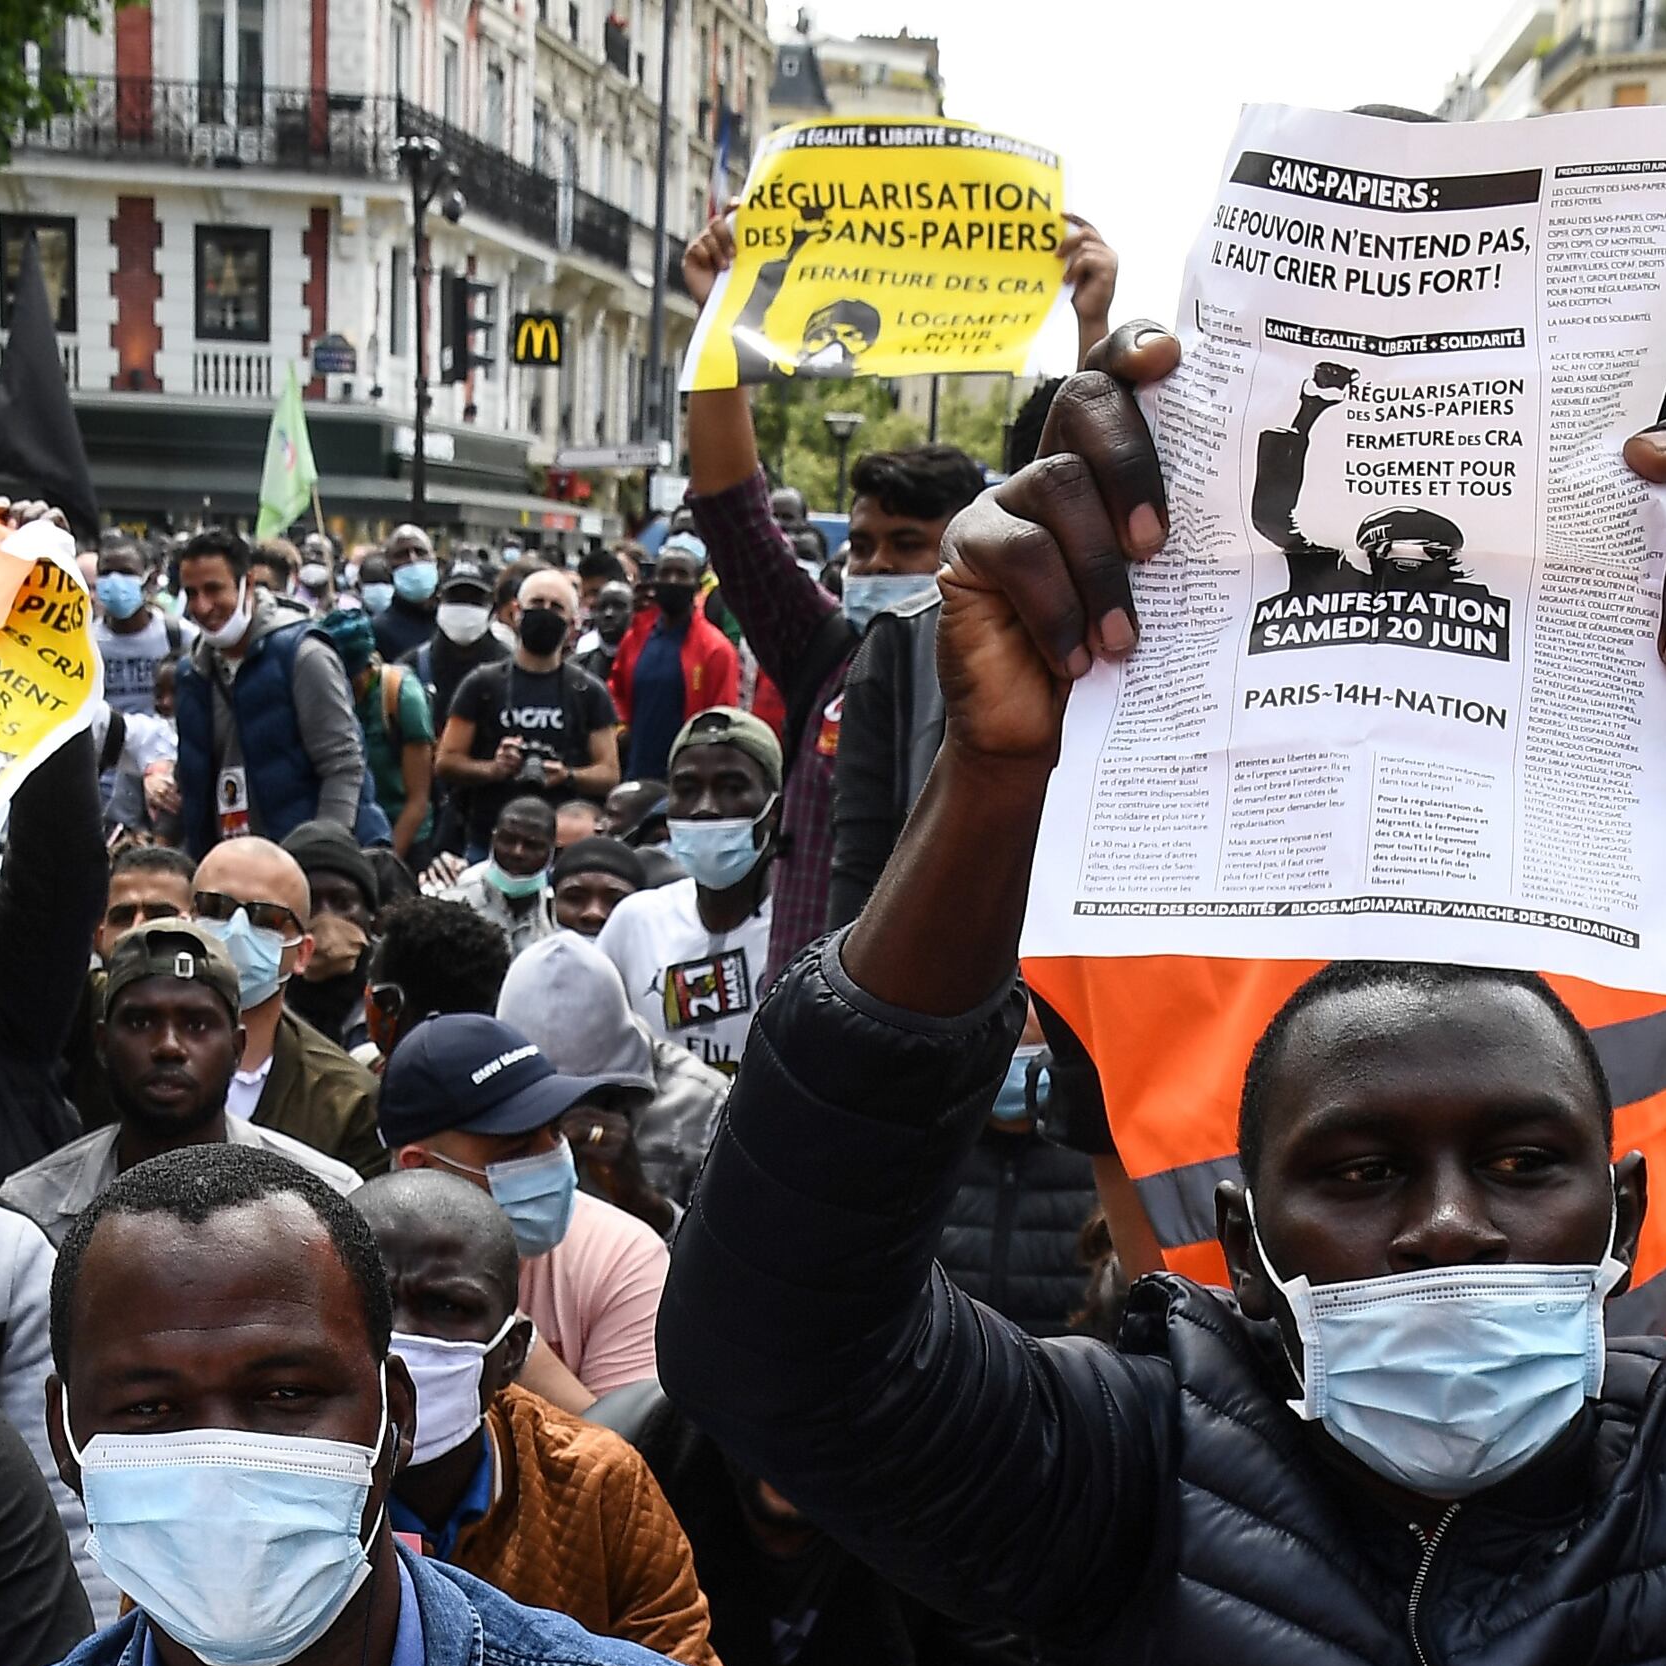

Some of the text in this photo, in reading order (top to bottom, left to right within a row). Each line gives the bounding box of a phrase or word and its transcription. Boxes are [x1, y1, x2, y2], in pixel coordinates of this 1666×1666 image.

[880, 126, 945, 146] LIBERTÉ
[748, 173, 1051, 211] RÉGULARISATION
[745, 219, 1058, 252] DES SANS-PAPIERS
[1223, 208, 1235, 230] LE
[1239, 211, 1325, 251] POUVOIR
[1332, 228, 1470, 261] N'ENTEND
[1477, 227, 1530, 255] PAS,
[798, 264, 1044, 293] FERMETURE DES CRA
[1212, 241, 1222, 264] IL
[1225, 244, 1271, 275] FAUT
[1274, 255, 1337, 290] CRIER
[1345, 269, 1410, 297] PLUS
[897, 311, 1036, 325] LOGEMENT
[1267, 323, 1522, 354] SANTÉ ÉGALITÉ LIBERTÉ SOLIDARITÉ
[1349, 379, 1524, 403] RÉGULARISATION
[1347, 399, 1513, 421] DES SANS-PAPIERS
[1346, 430, 1523, 449] FERMETURE DES CRA
[1346, 461, 1516, 477] LOGEMENT POUR
[1345, 480, 1512, 496] TOUTES ET TOUS
[1257, 592, 1505, 628] MANIFESTATION
[1263, 616, 1497, 653] SAMEDI 20 JUIN
[37, 647, 84, 680] CRA
[1401, 796, 1408, 804] la
[1411, 798, 1471, 812] régularisation
[1409, 808, 1421, 816] les
[1435, 823, 1479, 834] fermeture
[1434, 846, 1453, 854] Pour
[1435, 834, 1477, 845] logement
[1080, 904, 1095, 914] FB
[1098, 904, 1156, 914] MARCHE
[1159, 904, 1185, 915] DES
[1187, 902, 1276, 915] SOLIDARITÉS
